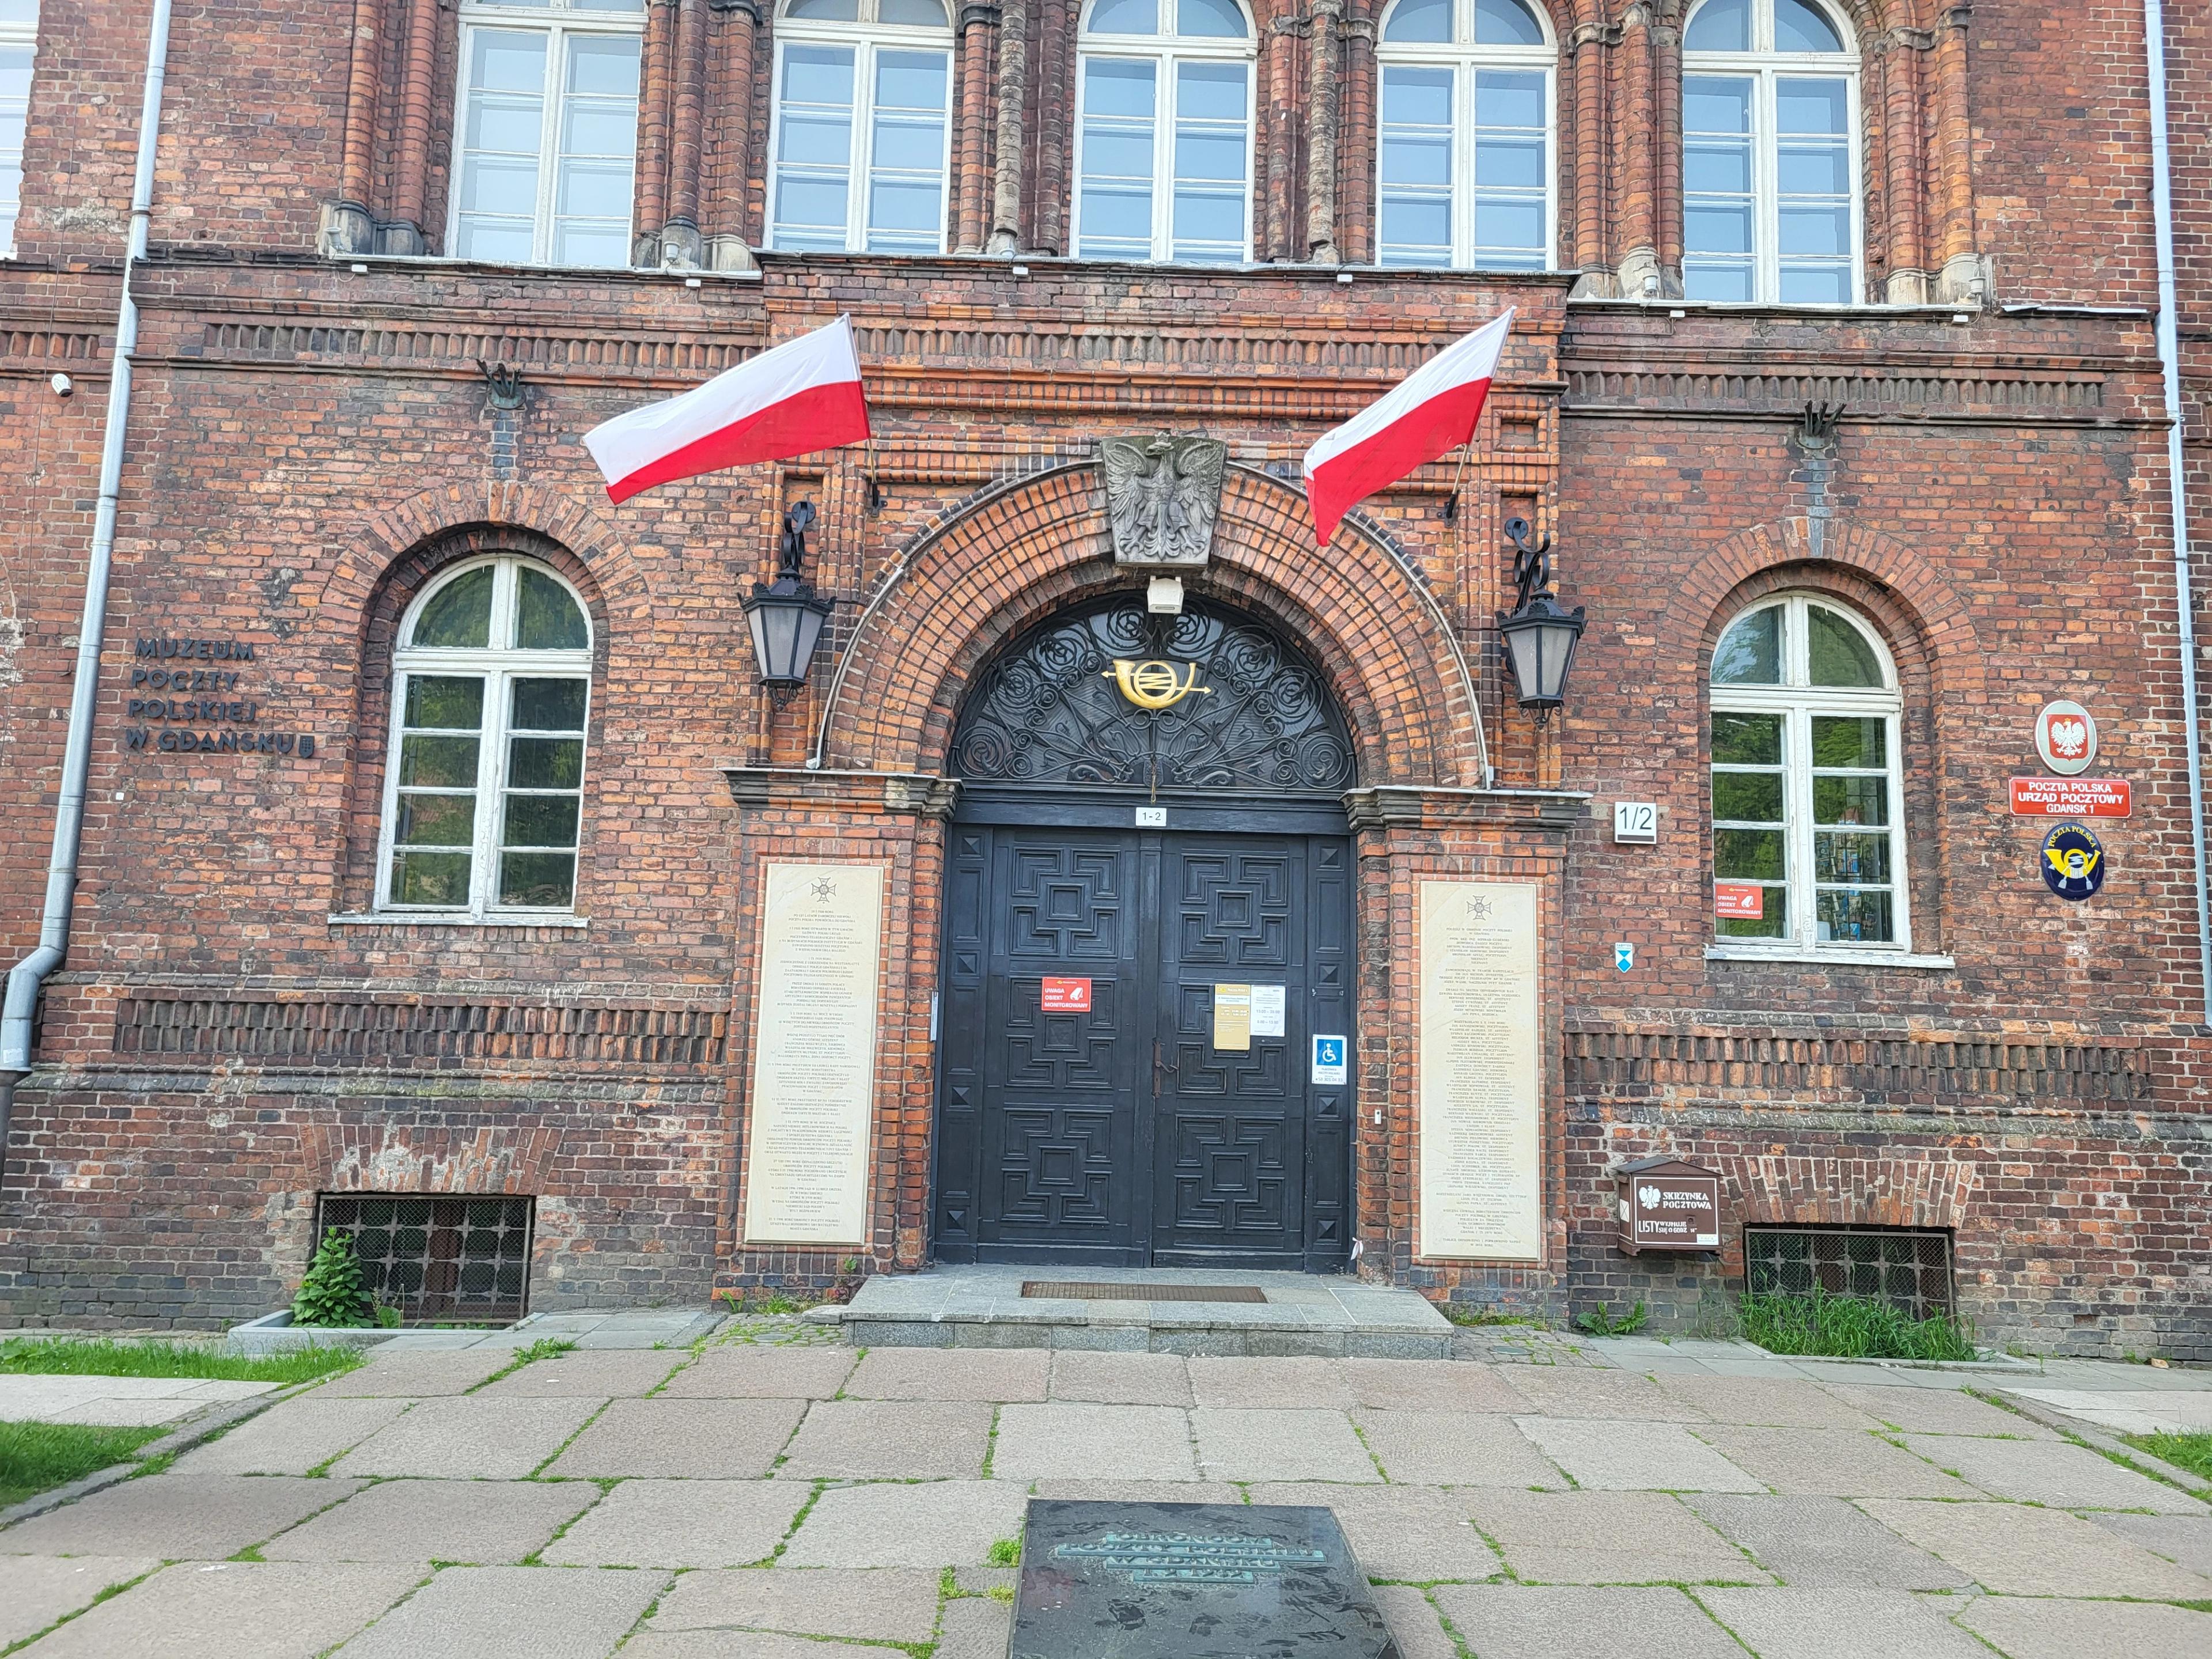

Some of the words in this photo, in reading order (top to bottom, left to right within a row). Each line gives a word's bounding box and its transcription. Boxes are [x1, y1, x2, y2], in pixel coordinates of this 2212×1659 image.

[135, 638, 254, 660] MUZEUM
[131, 669, 240, 690] POCZTY
[128, 699, 256, 720] POLSKIEJ
[126, 729, 149, 748] W
[158, 727, 295, 753] GDAŃSKU
[2029, 782, 2069, 792] POCZTA
[2071, 783, 2112, 793] POLSKA
[2018, 792, 2057, 803] URZĄD
[2061, 794, 2124, 804] POCZTOWY
[2046, 804, 2087, 813] GDAŃSK
[2089, 805, 2094, 813] 1
[1619, 806, 1652, 830] 1/2
[2048, 826, 2071, 847] POCZTA
[2071, 825, 2096, 848] POLSKA
[1662, 1192, 1709, 1200] SKRZYNKA
[1662, 1201, 1711, 1209] POCZTOWA
[1638, 1221, 1658, 1232] LISTY
[1065, 1543, 1171, 1552] POCZTY
